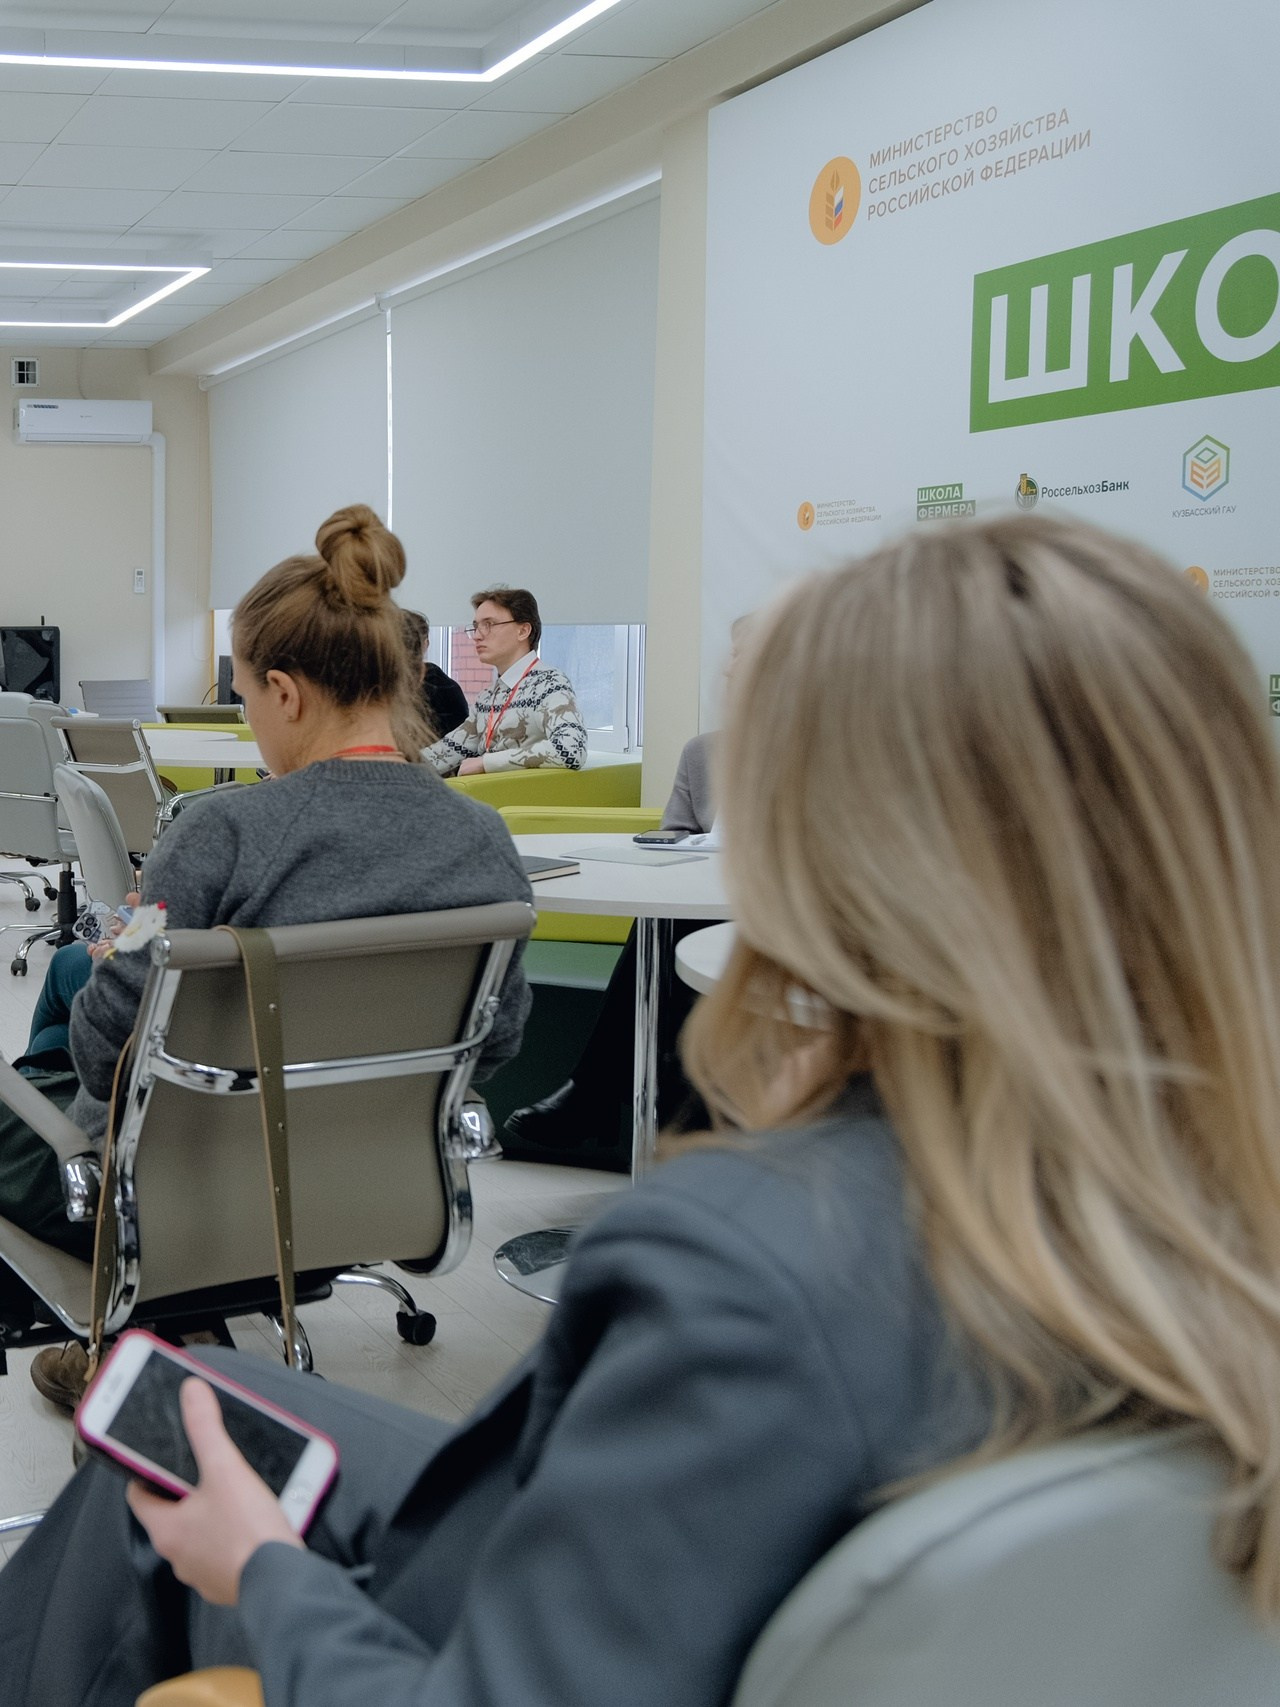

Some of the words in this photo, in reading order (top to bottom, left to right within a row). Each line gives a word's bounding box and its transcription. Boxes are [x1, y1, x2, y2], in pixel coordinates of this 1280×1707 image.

[870, 106, 998, 169] МИНИСТЕРСТВО
[869, 149, 959, 194] СЕЛЬСКОГО
[964, 108, 1070, 161] ХОЗЯЙСТВА
[867, 168, 975, 221] РОССИЙСКОЙ
[980, 129, 1092, 182] ФЕДЕРАЦИИ
[988, 229, 1280, 405] ШКО
[918, 485, 961, 500] ШКОЛА
[1041, 480, 1130, 498] РоссельхозБанк
[918, 502, 974, 519] ФЕРМЕРА
[1172, 505, 1220, 518] КУЗБАССКИЙ
[1222, 505, 1236, 514] ГАУ
[1213, 566, 1280, 576] МИНИСТЕРСТВО
[1213, 578, 1262, 588] СЕЛЬСКОГО
[1213, 589, 1271, 599] РОССИЙСКОЙ
